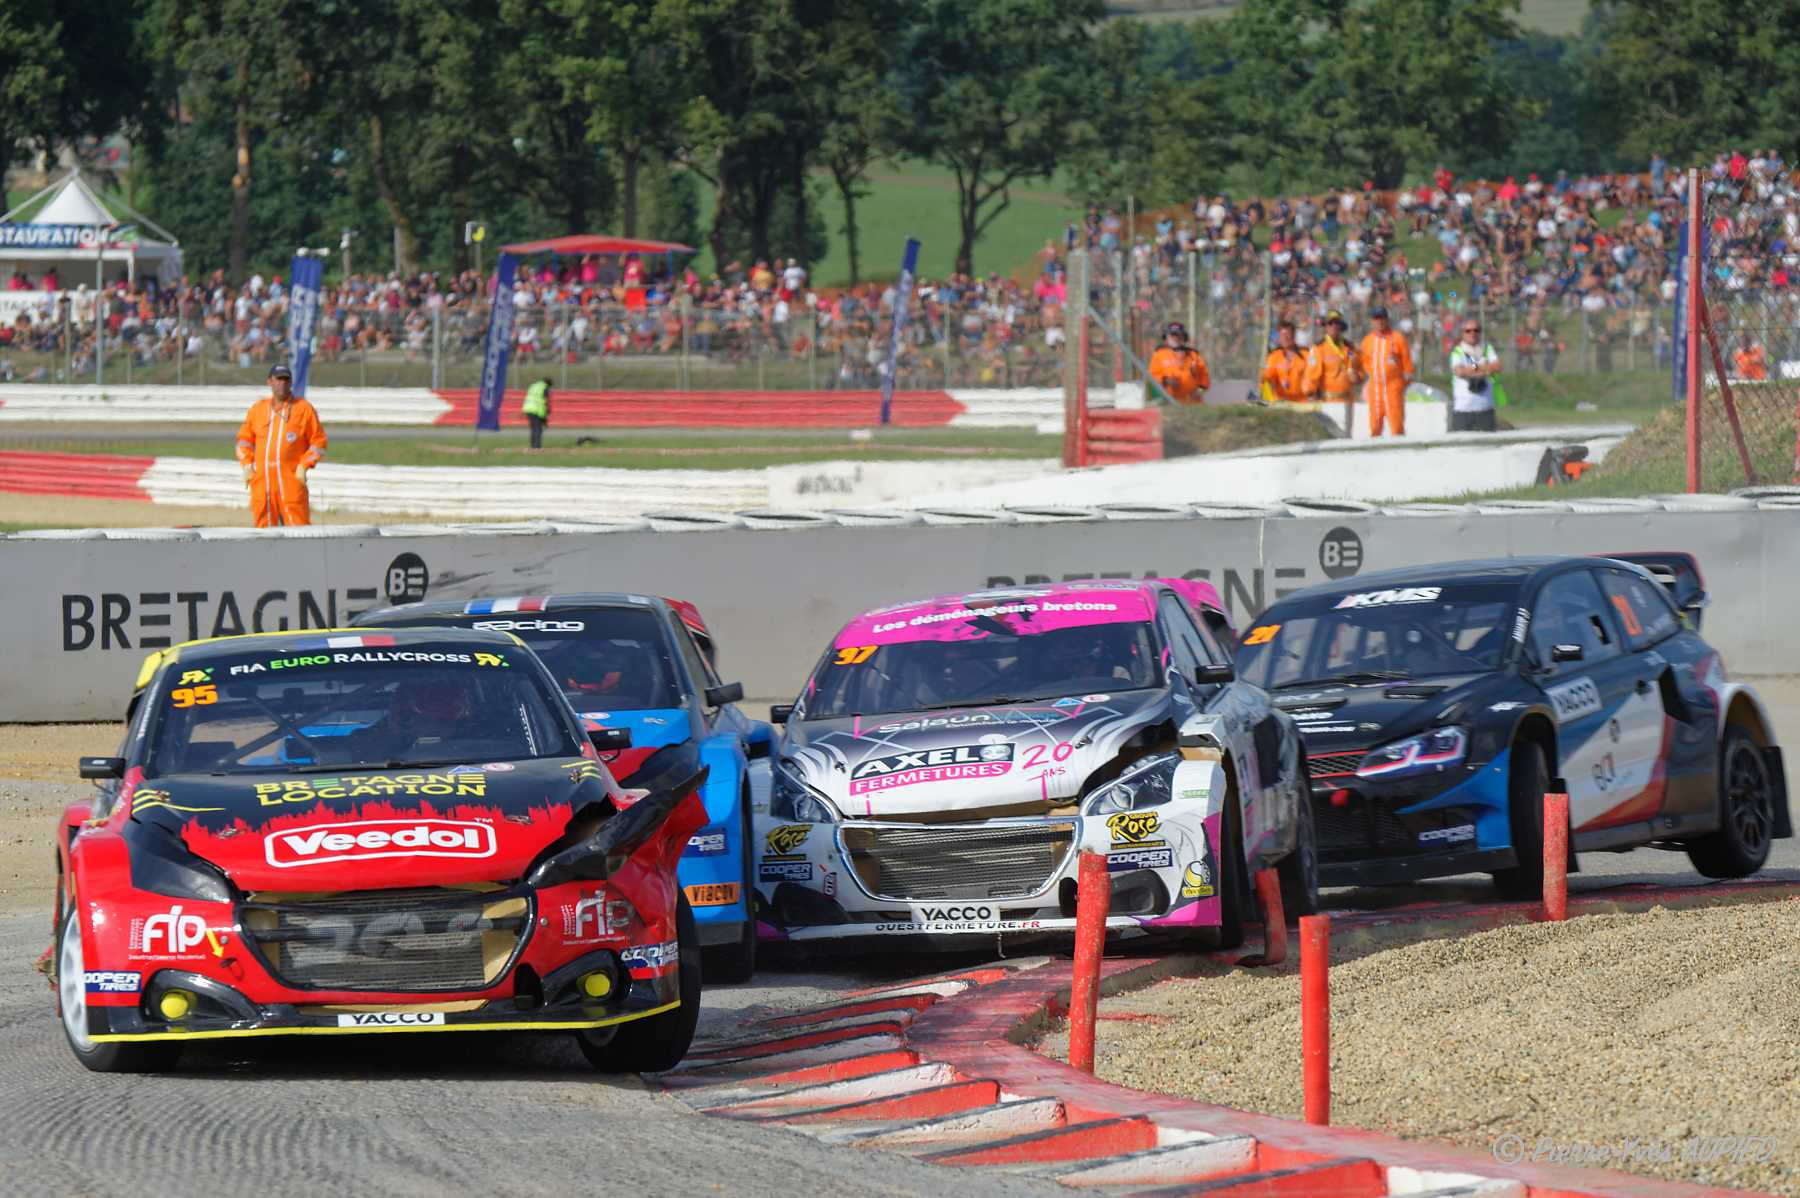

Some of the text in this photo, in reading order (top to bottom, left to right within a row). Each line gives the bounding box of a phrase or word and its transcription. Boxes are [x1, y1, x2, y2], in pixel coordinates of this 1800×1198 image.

[1042, 600, 1118, 612] bretons
[229, 650, 472, 676] FIA EURO RALLYCROSS
[170, 684, 219, 709] 95
[1022, 740, 1073, 770] 20
[253, 772, 486, 795] BRETAGNE
[855, 763, 1004, 793] FERMETURES
[256, 783, 487, 807] LOCATION
[1106, 812, 1163, 843] Rose
[282, 825, 481, 856] Veedol
[760, 863, 812, 874] COOPER
[1106, 850, 1170, 864] COOPER
[1137, 860, 1169, 868] TIRES
[920, 906, 992, 921] YACCO
[99, 983, 138, 992] TIRES
[352, 1012, 435, 1025] YACCO
